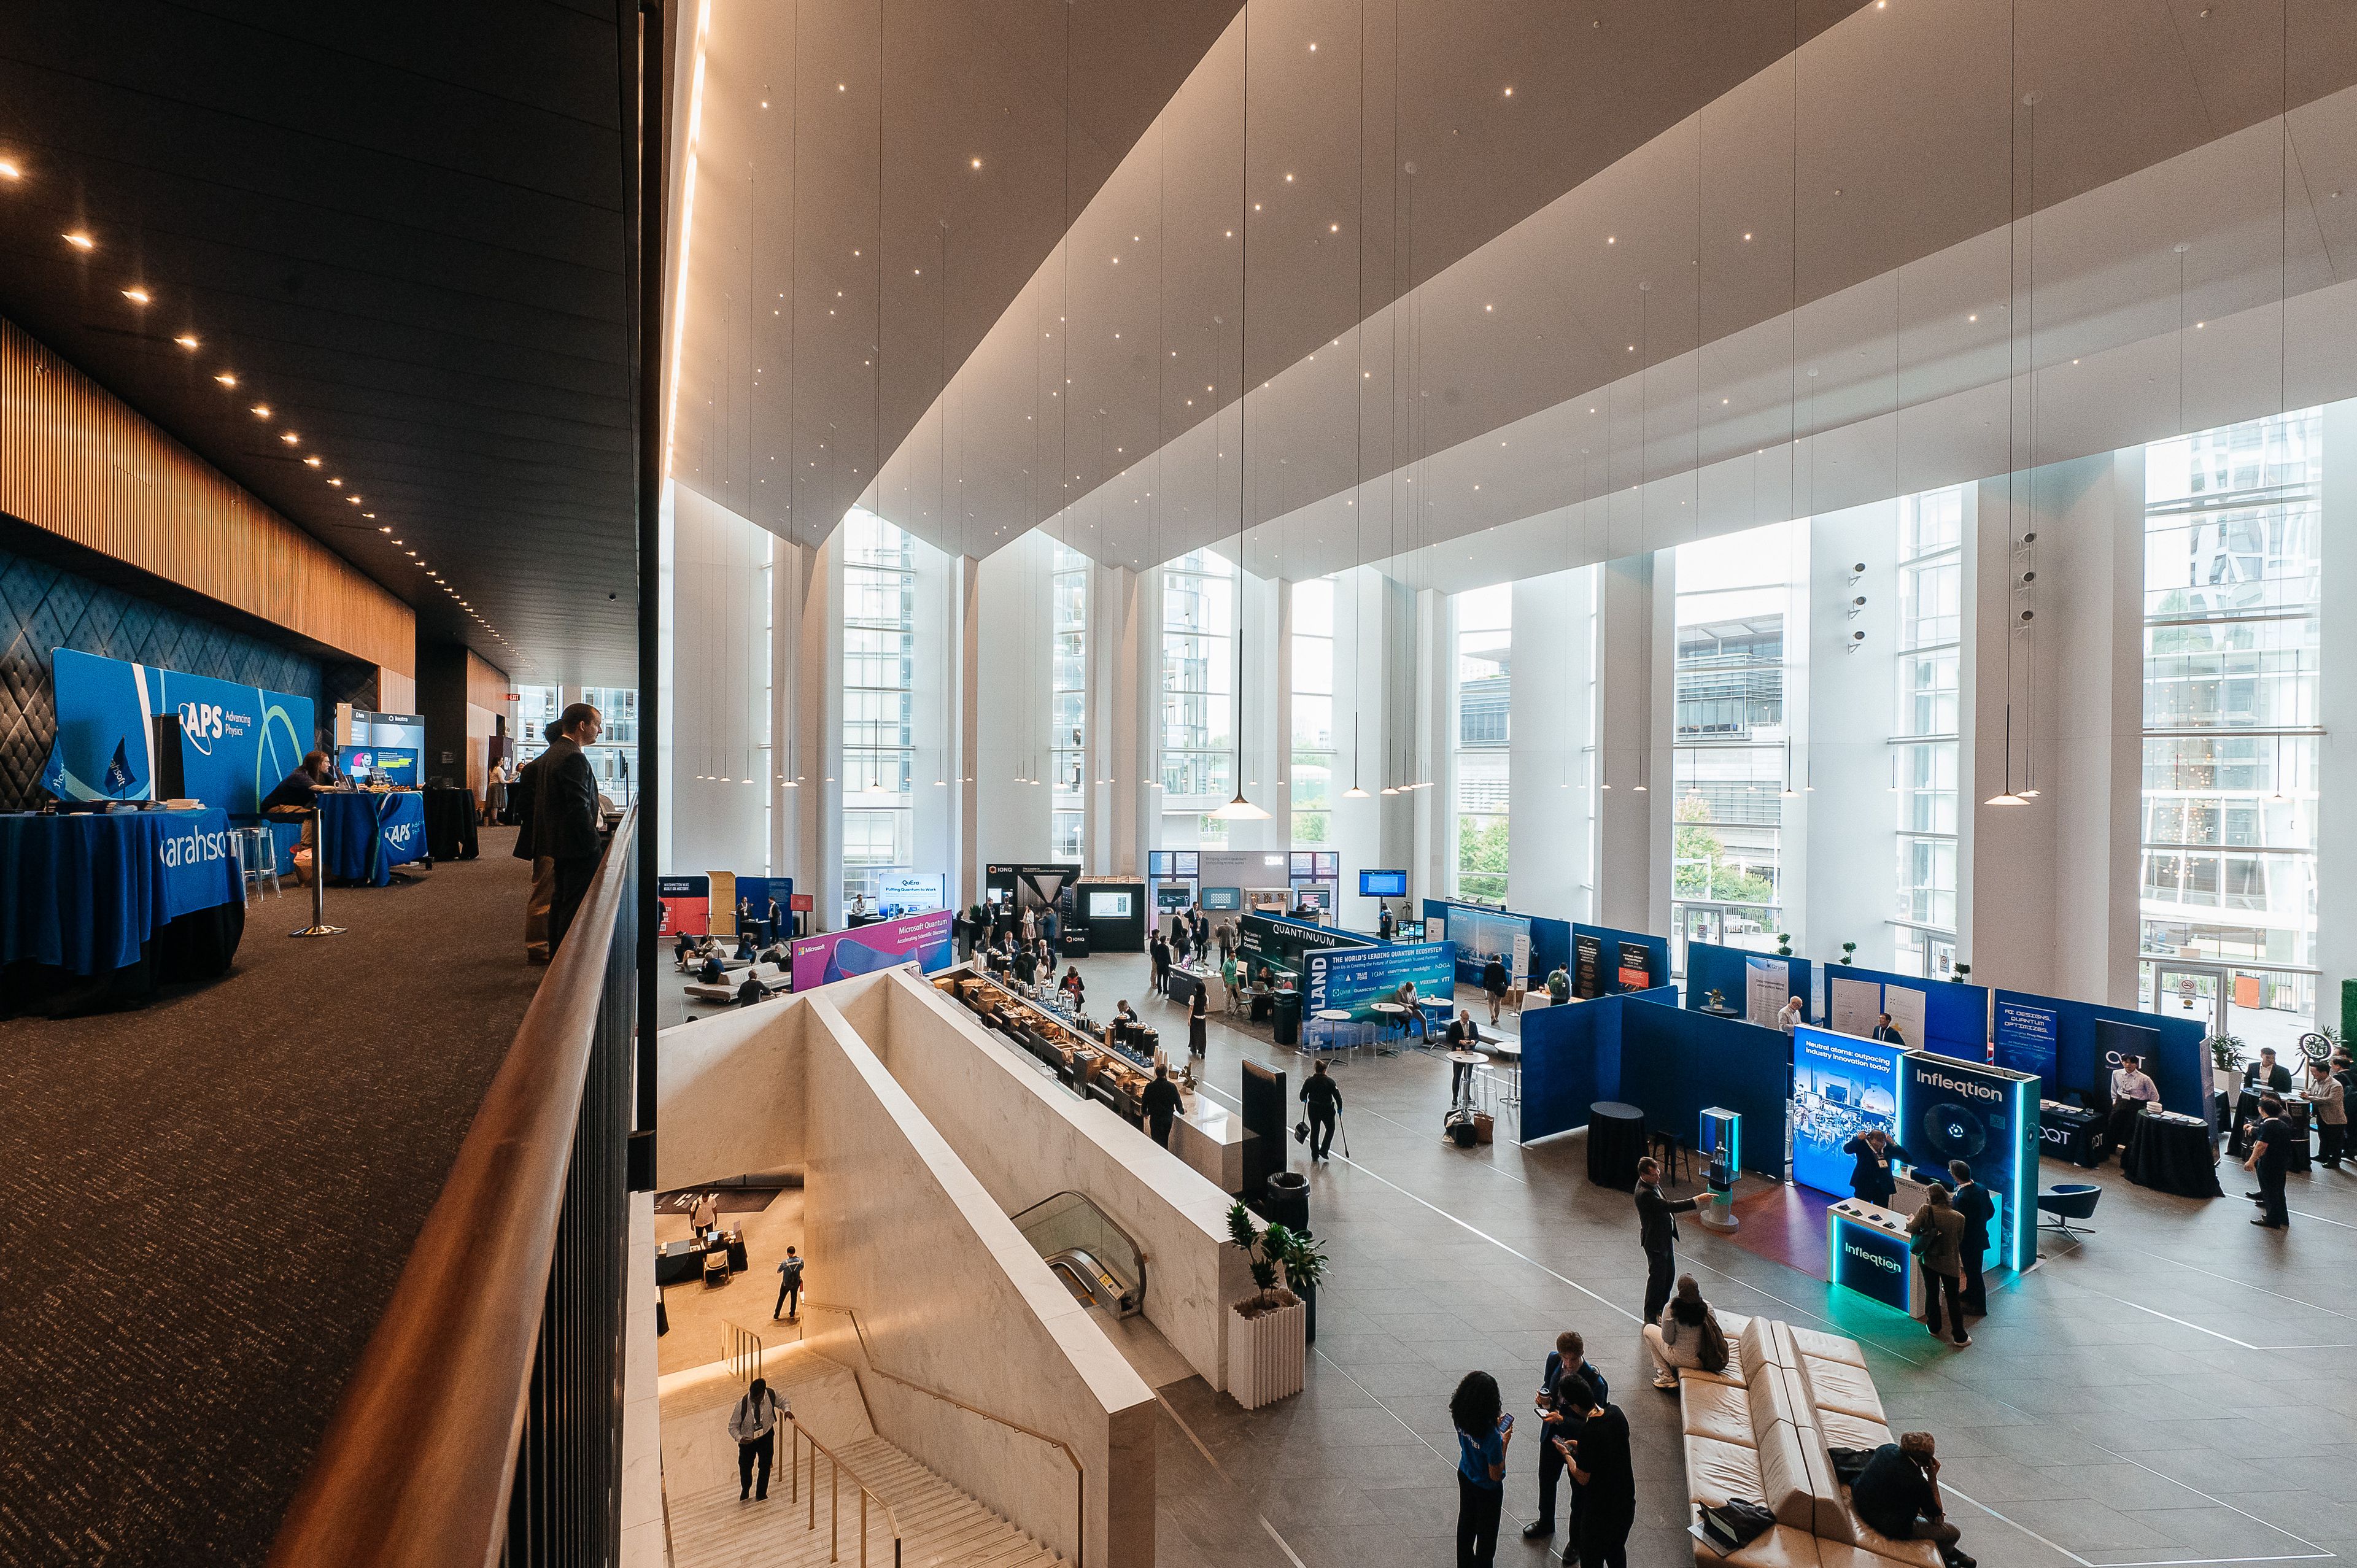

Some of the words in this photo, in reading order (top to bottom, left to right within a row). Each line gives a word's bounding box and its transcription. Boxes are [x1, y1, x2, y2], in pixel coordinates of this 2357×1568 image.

[186, 702, 223, 739] APS
[225, 710, 251, 727] Advancing
[225, 724, 243, 738] Physics
[391, 823, 411, 843] APS
[899, 922, 924, 935] Microsoft
[924, 919, 947, 929] Quantum
[897, 935, 918, 944] Accelerating
[1244, 936, 1259, 944] Quantum
[1273, 924, 1335, 946] QUANTINUUM
[805, 943, 825, 952] Microsoft
[1244, 941, 1262, 952] Computing
[1344, 954, 1367, 962] WORLD'S
[1415, 946, 1442, 955] ECOSYSTEM
[2010, 1016, 2045, 1026] QUANTUM
[2016, 1011, 2051, 1022] DESIGNS.
[2004, 1021, 2048, 1033] OPTIMIZES.
[1806, 1040, 1830, 1051] Neutral
[1830, 1046, 1854, 1057] atoms:
[1854, 1052, 1891, 1067] outpacing
[2105, 1050, 2146, 1069] OT
[1869, 1062, 1891, 1073] today
[1917, 1069, 2002, 1102] Infleqtion
[1895, 1180, 1920, 1191] recision
[1845, 1242, 1902, 1273] Infleqtion
